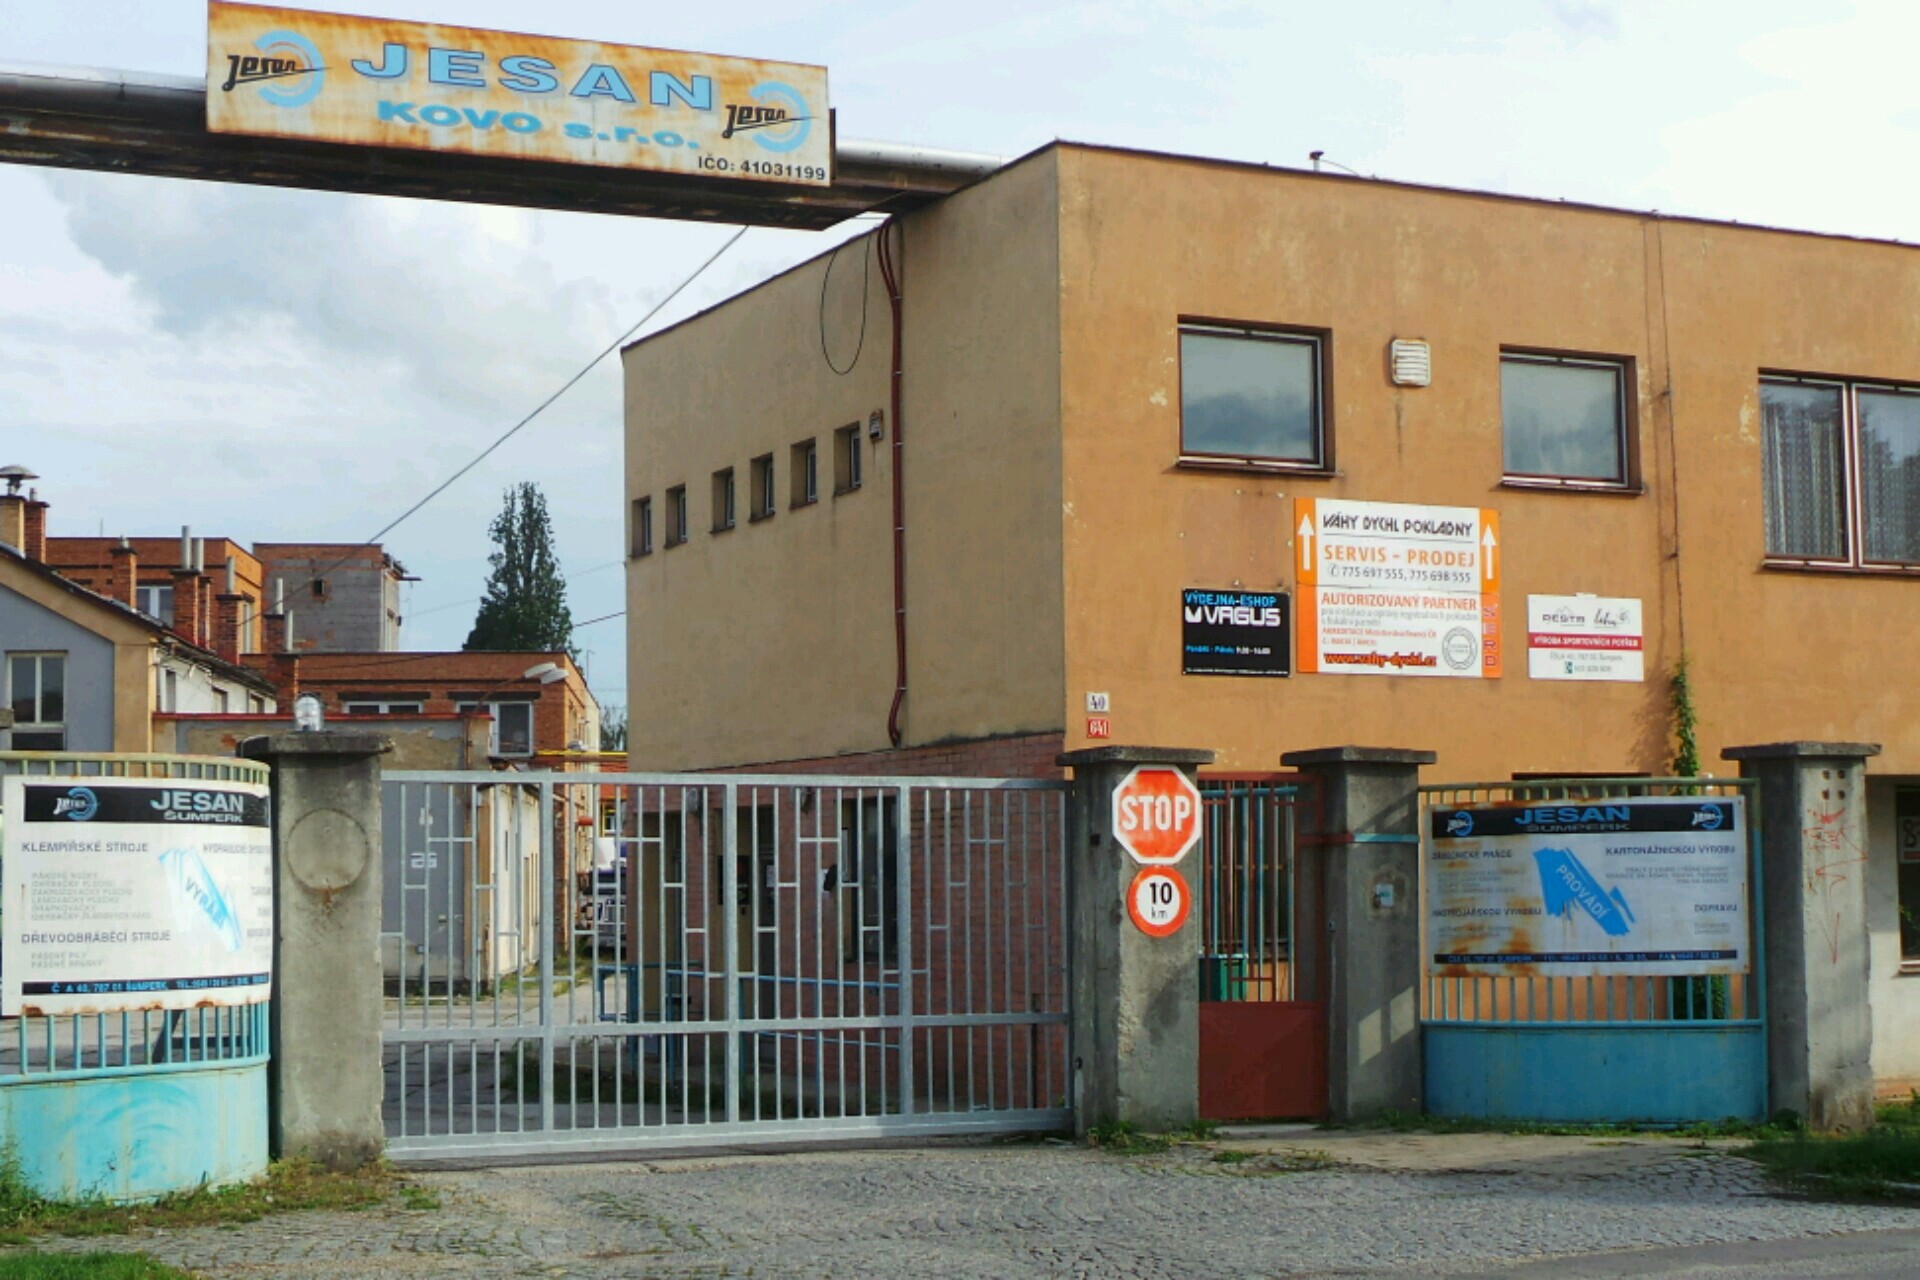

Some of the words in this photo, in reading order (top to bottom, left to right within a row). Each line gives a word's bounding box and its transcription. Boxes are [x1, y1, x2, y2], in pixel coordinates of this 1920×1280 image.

[351, 42, 713, 111] JESAN
[377, 100, 544, 134] KOVO
[563, 121, 700, 150] s.r.o.
[698, 154, 735, 173] IČO:
[740, 158, 826, 181] 41031199
[1323, 511, 1358, 529] VÁHY
[1363, 517, 1399, 532] DYCHL
[1404, 519, 1473, 536] POKLADNY
[1325, 545, 1387, 562] SERVIS
[1408, 549, 1475, 567] PRODEJ
[1423, 596, 1477, 611] PARTNER
[1203, 605, 1280, 627] VAGUS
[149, 789, 244, 813] JESAN
[164, 810, 243, 823] ŠUMPERK
[1121, 795, 1192, 832] STOP
[1514, 806, 1631, 825] JESAN
[106, 842, 148, 852] STROJE
[1149, 882, 1173, 905] 10
[1556, 864, 1612, 920] PROVÁDÍ
[1151, 907, 1168, 919] km
[131, 931, 170, 942] STROJE
